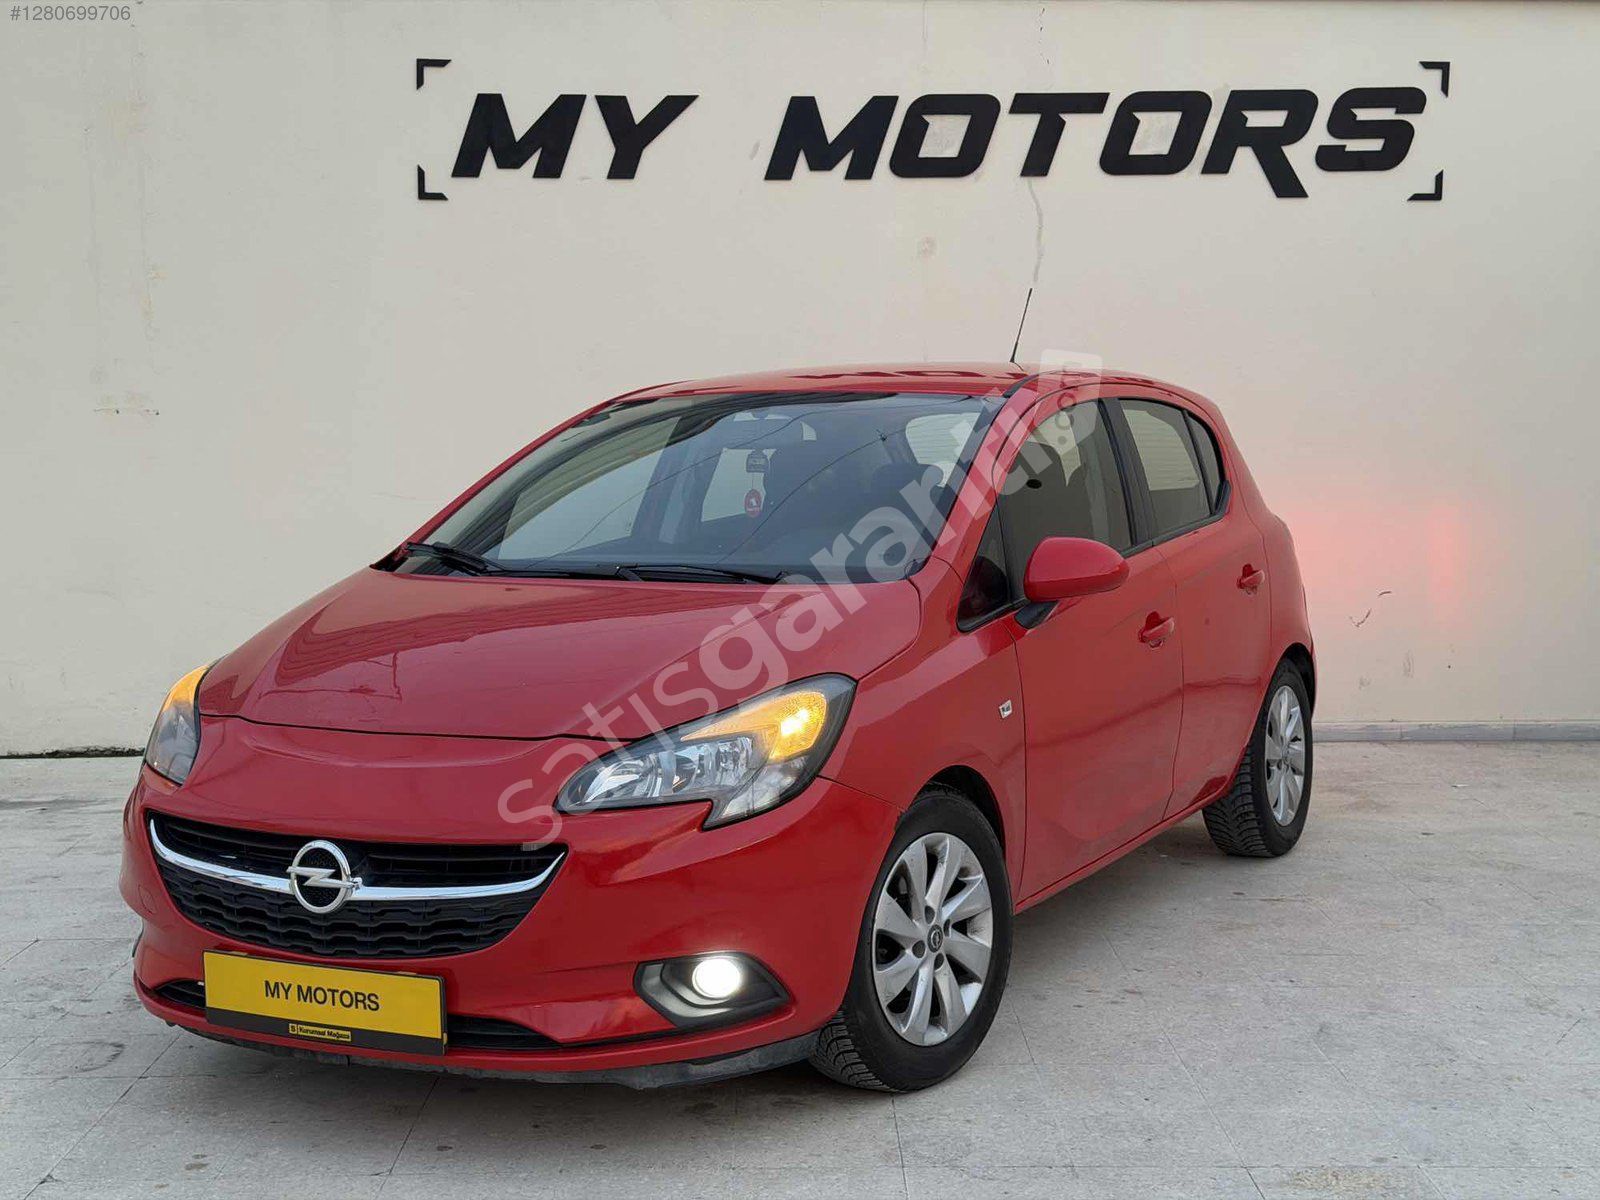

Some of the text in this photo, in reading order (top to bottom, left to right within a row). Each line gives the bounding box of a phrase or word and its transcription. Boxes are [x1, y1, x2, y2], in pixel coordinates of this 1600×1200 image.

[451, 86, 1427, 198] MY MOTORS
[264, 980, 380, 1011] MY MOTORS
